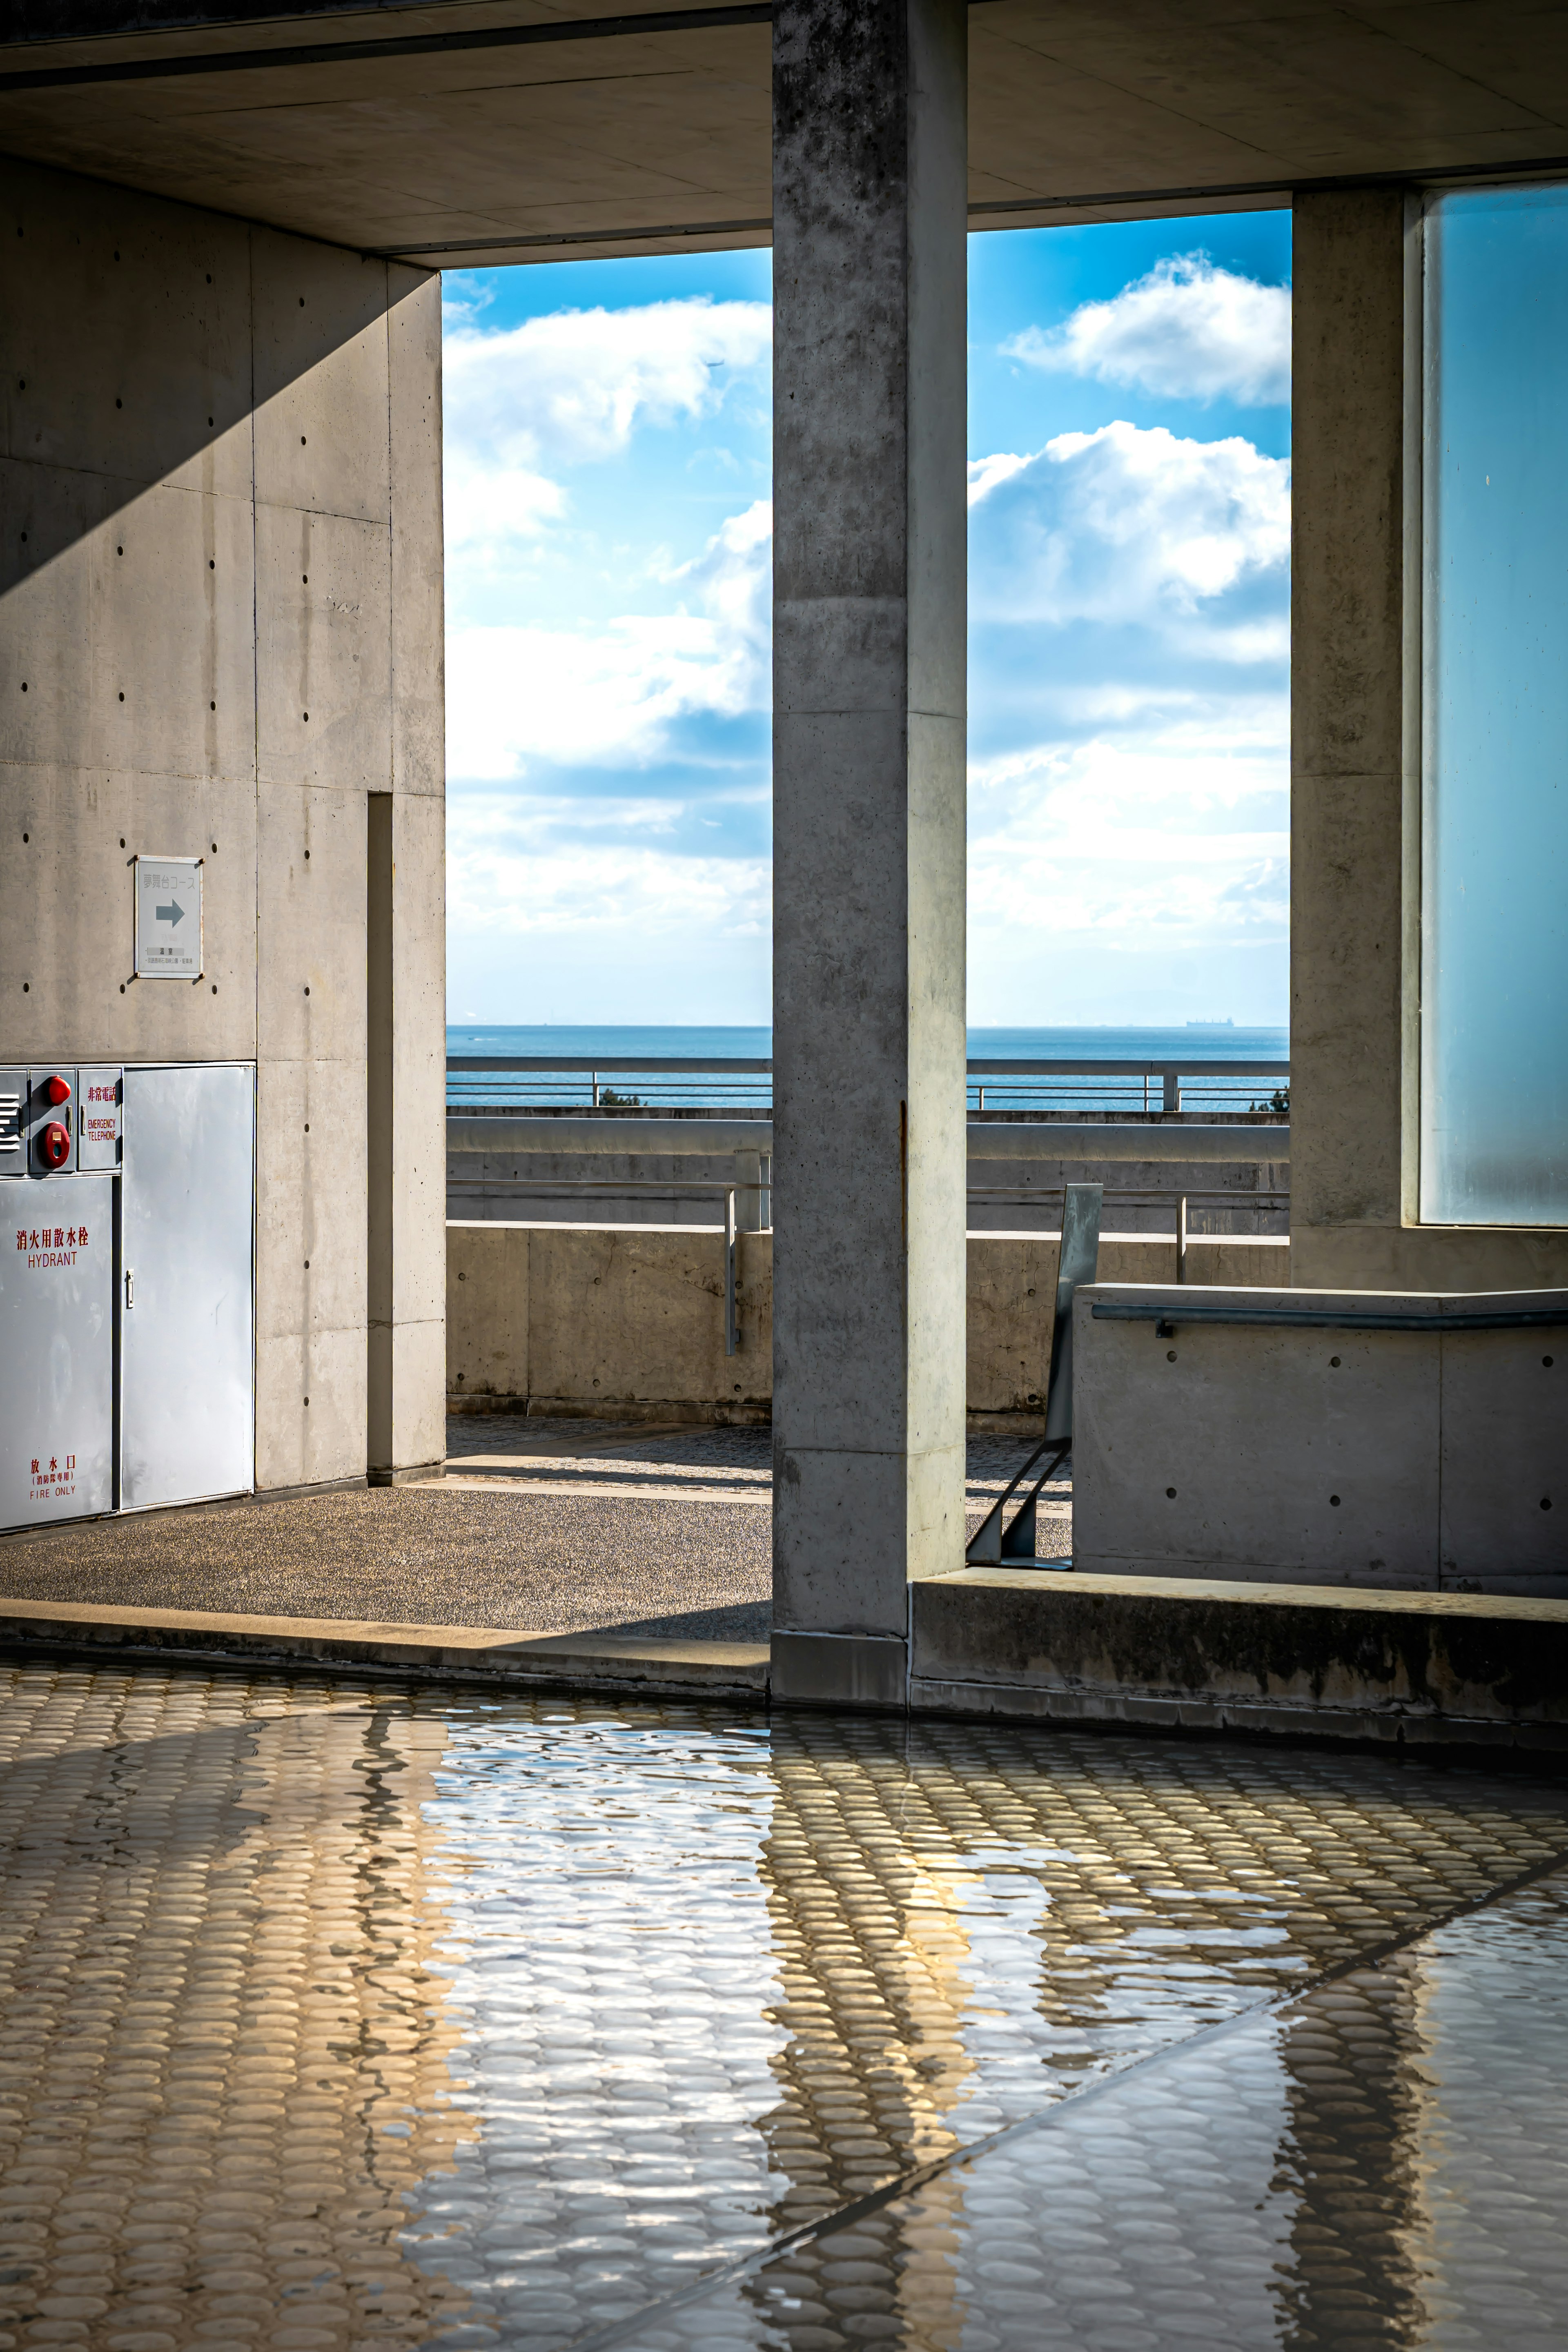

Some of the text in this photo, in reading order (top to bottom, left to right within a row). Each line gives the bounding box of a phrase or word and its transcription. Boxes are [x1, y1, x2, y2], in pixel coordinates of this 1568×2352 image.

[144, 874, 195, 889] 夢舞台コース
[88, 1087, 116, 1102] 非常電話
[88, 1119, 116, 1129] EMERGENCY
[88, 1131, 116, 1140] TELEPHONE
[16, 1227, 88, 1250] 消火用散水栓
[28, 1252, 77, 1268] HYDRANT
[31, 1455, 75, 1474] 放水口
[30, 1485, 75, 1500] FIRE ONLY
